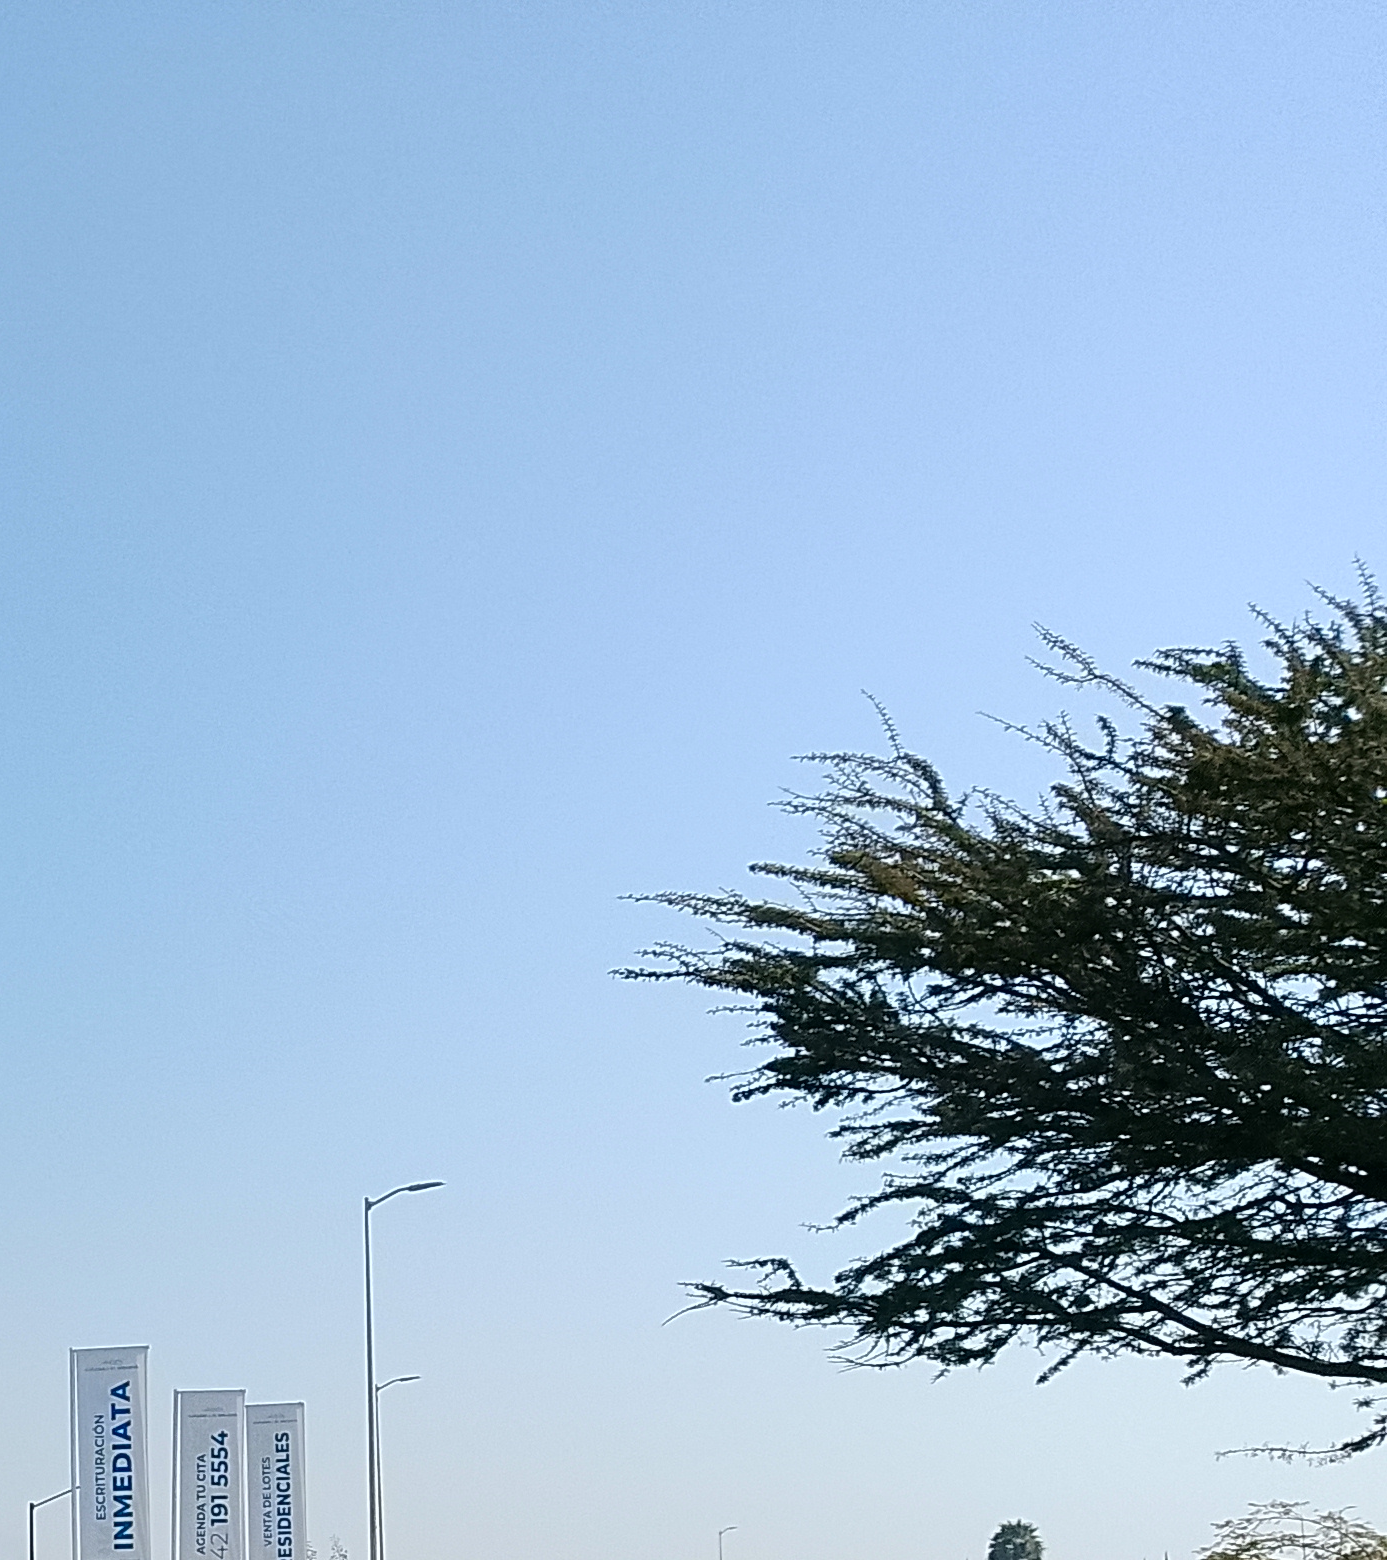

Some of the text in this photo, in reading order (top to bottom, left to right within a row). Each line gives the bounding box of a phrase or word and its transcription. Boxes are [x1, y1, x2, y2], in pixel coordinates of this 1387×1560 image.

[92, 1414, 107, 1520] ESCRITURACIÓN
[109, 1380, 134, 1550] INMEDIATA
[195, 1453, 207, 1556] AGENDA TU CITA
[210, 1429, 229, 1488] 5554
[261, 1456, 273, 1547] VENTA DE LOTES
[210, 1494, 229, 1527] 191
